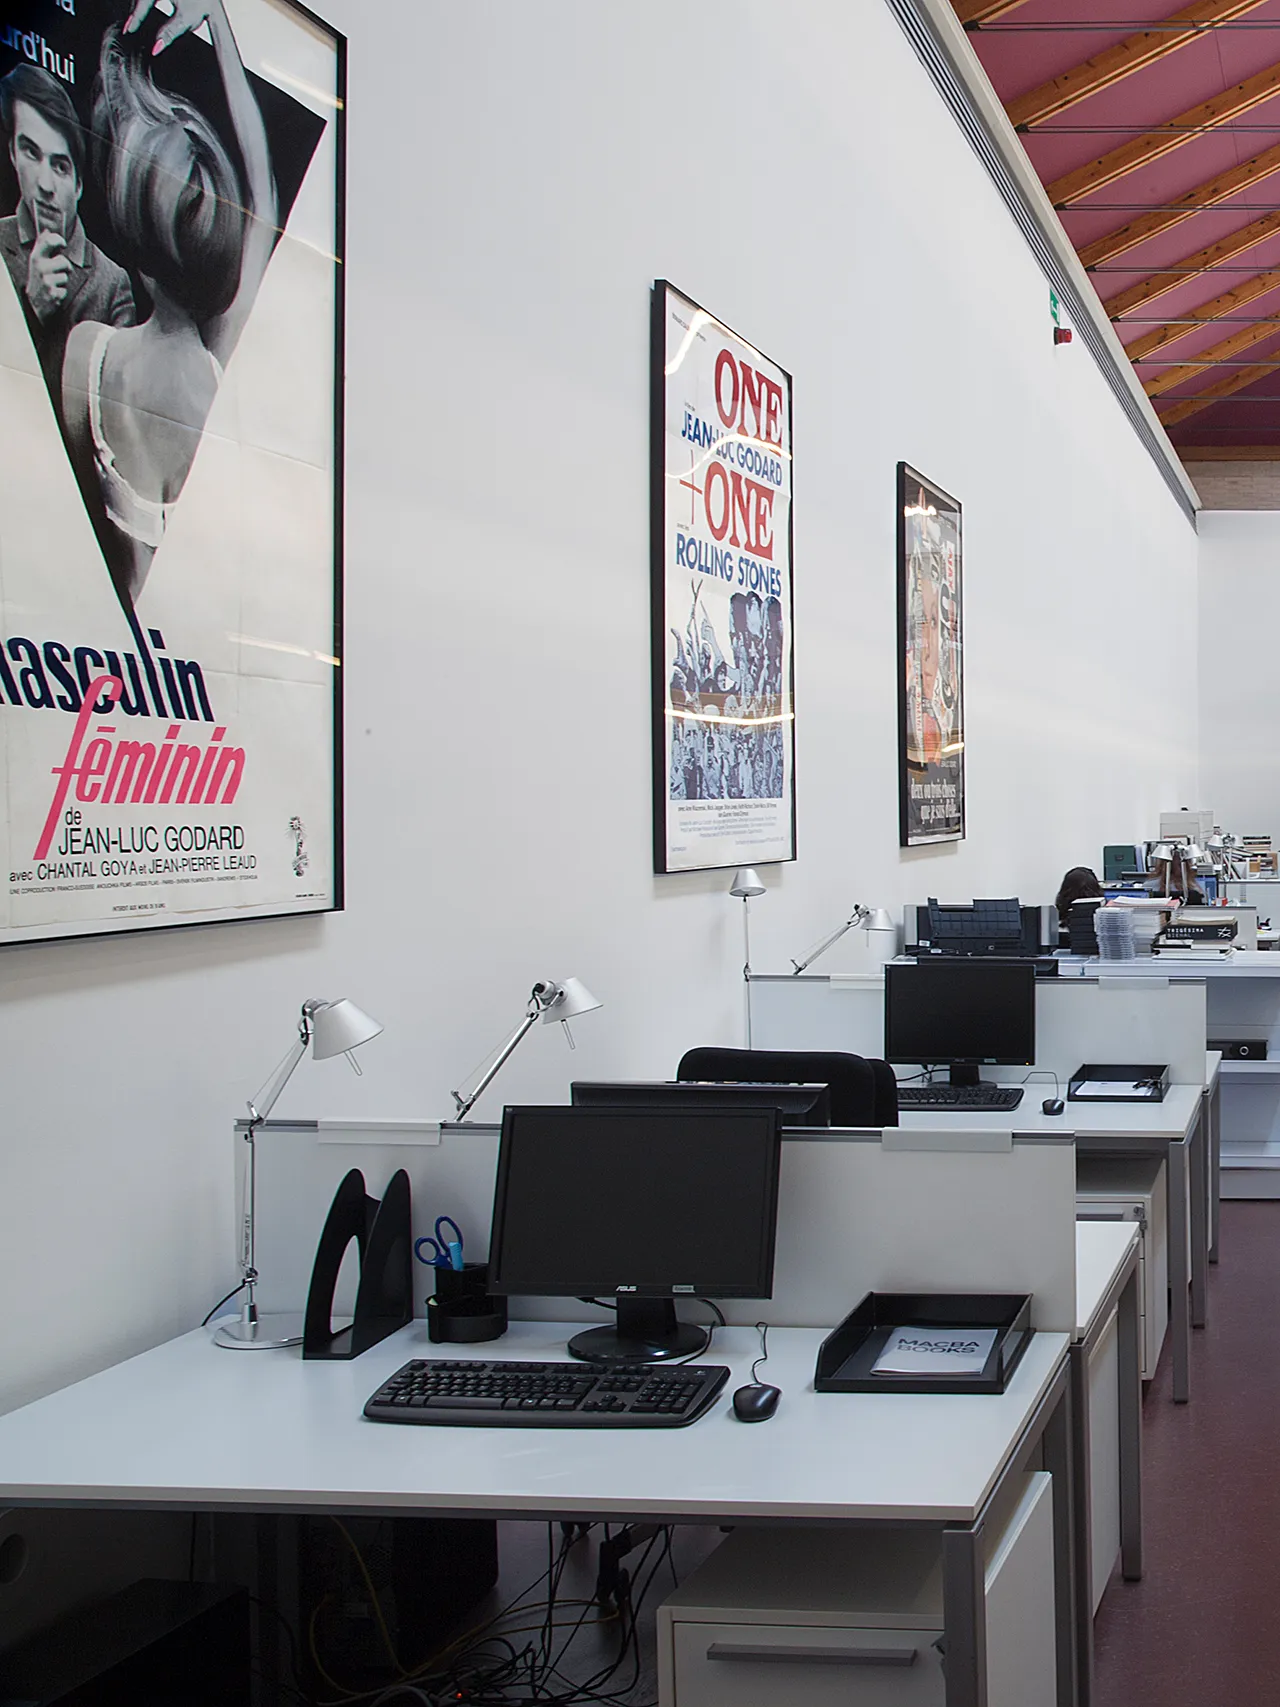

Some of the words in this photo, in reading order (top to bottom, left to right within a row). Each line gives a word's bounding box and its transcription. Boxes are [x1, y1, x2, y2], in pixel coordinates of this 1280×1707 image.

[715, 349, 782, 457] ONE
[737, 442, 782, 487] GODARD
[704, 461, 774, 561] ONE
[676, 533, 734, 582] ROLLING
[738, 556, 782, 598] STONES
[65, 806, 82, 825] de
[58, 826, 159, 856] JEAN-LUC
[164, 826, 245, 852] GODARD
[9, 870, 34, 882] avec
[37, 861, 97, 880] CHANTAL
[100, 860, 138, 877] GOYA
[139, 863, 147, 875] et
[148, 856, 219, 874] JEAN-PIERRE
[222, 854, 258, 871] LEAUD
[897, 1345, 976, 1354] BOOKS
[899, 1338, 980, 1348] MACBA
